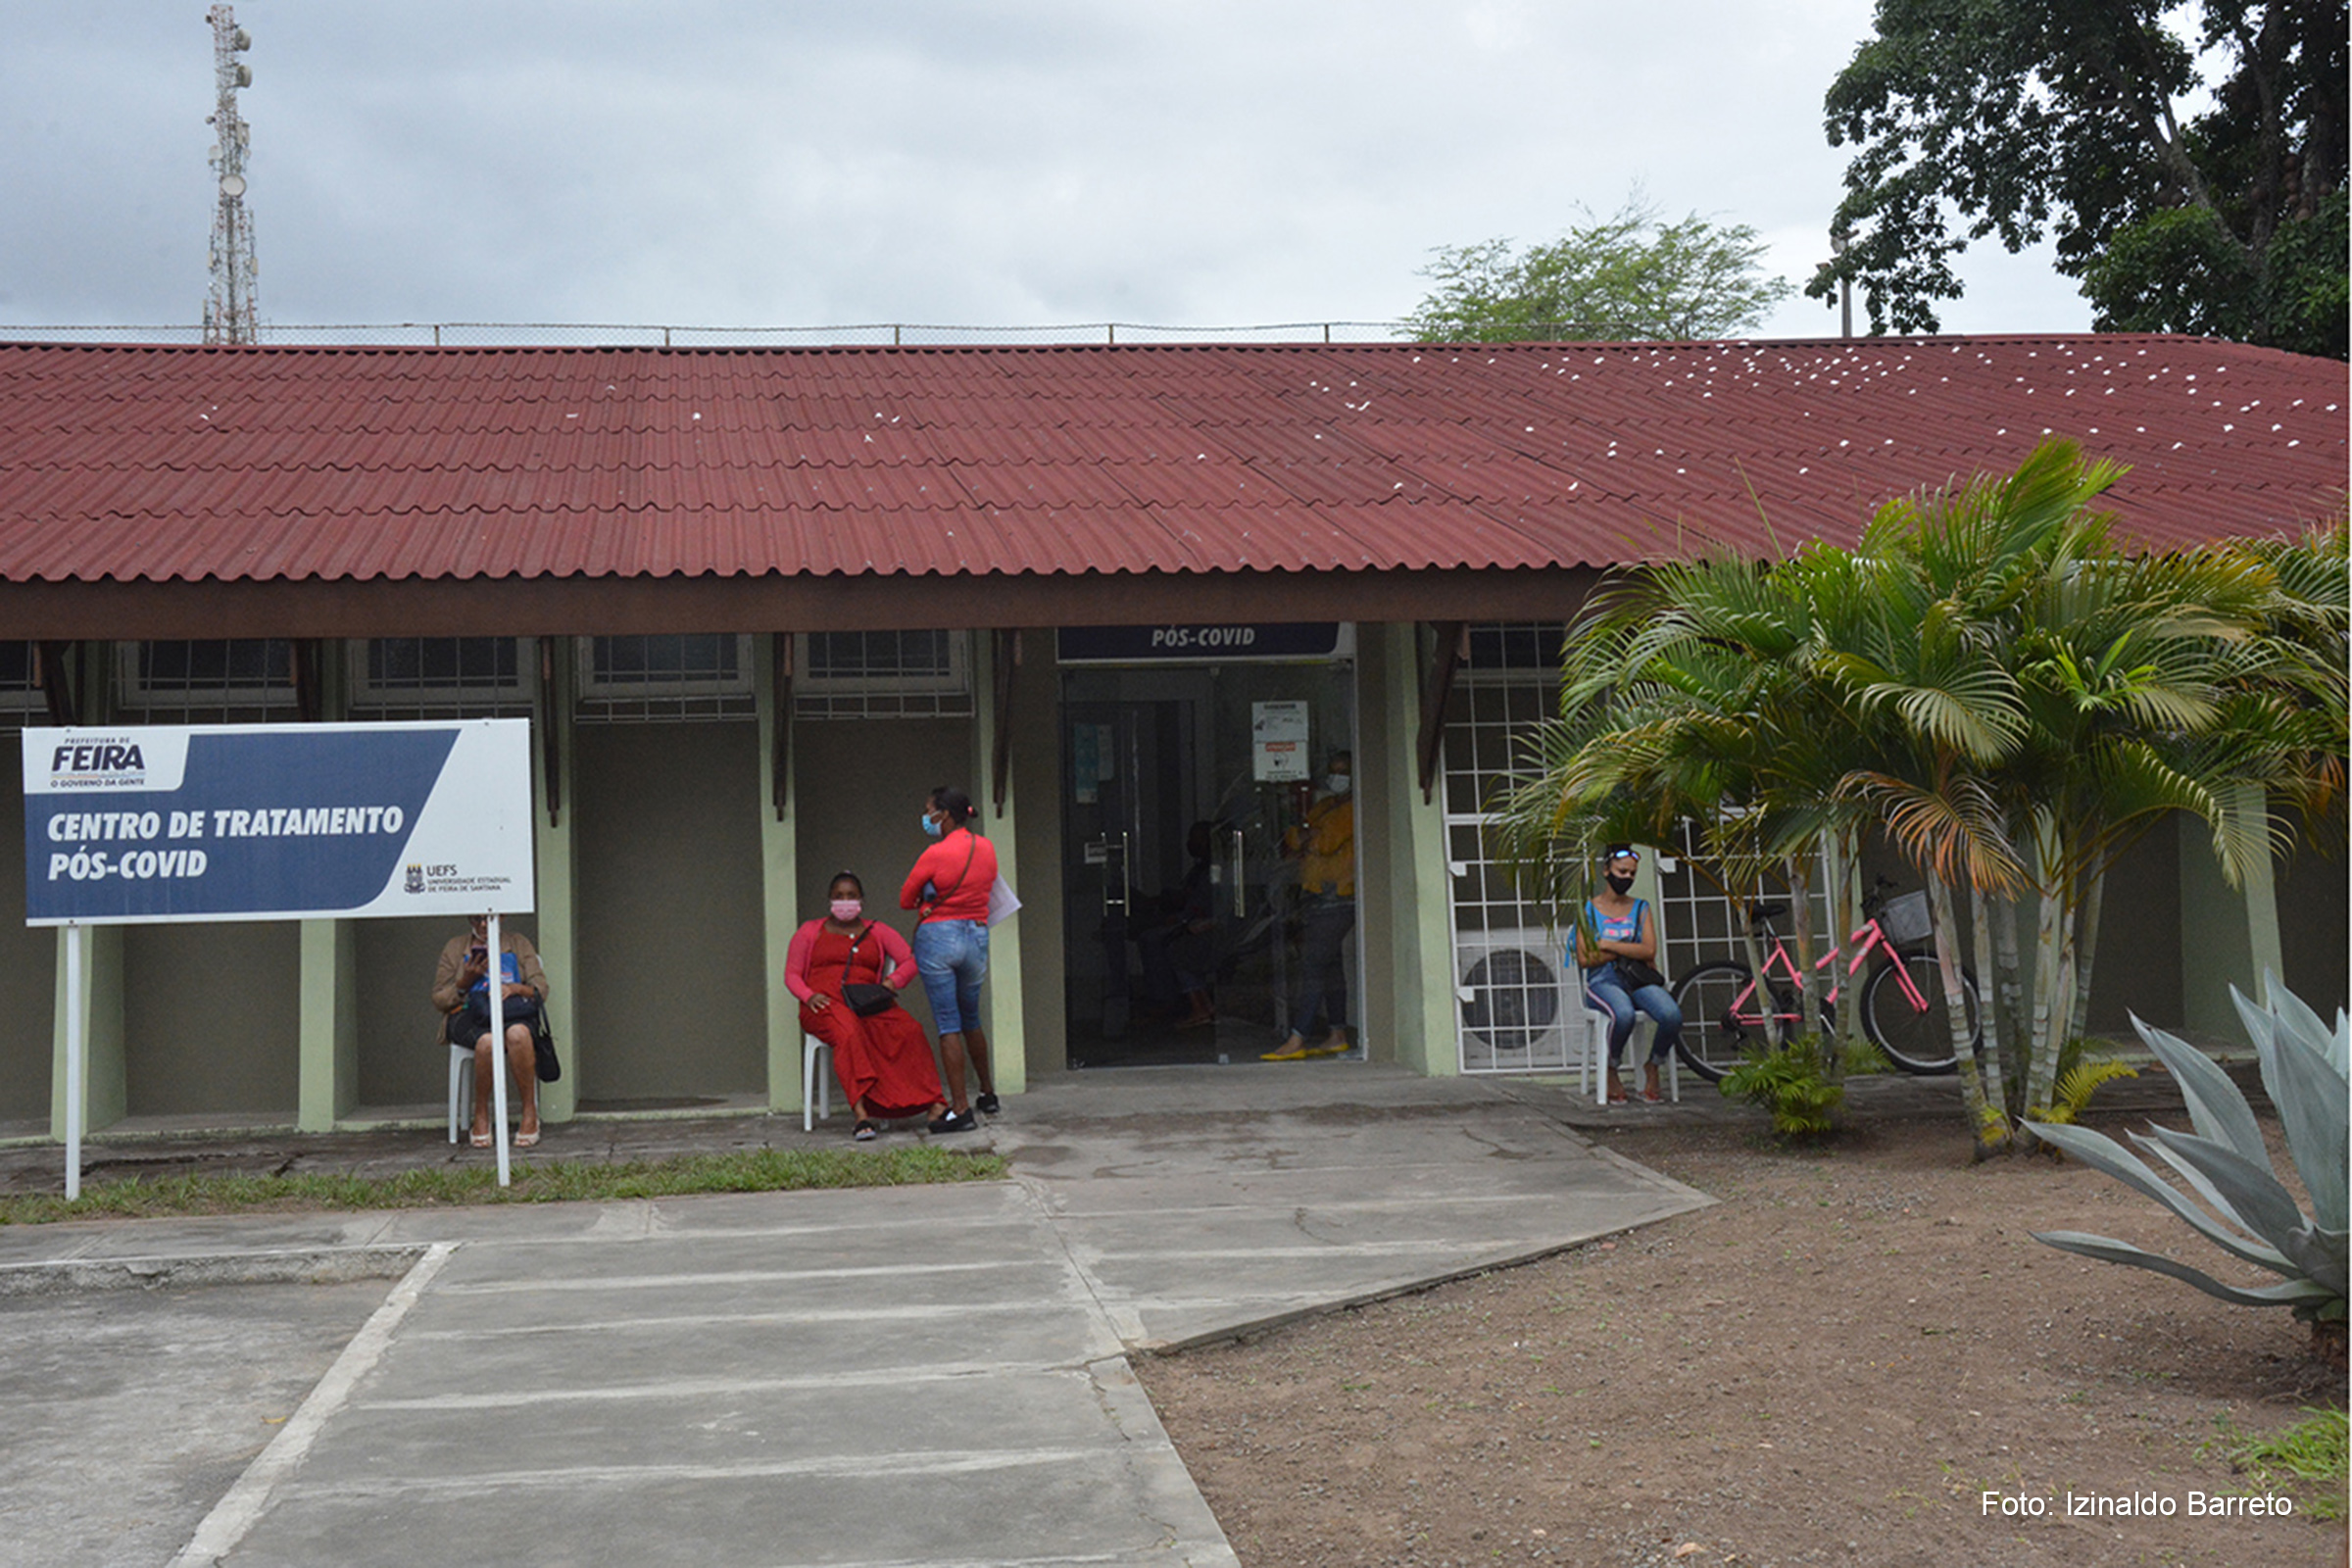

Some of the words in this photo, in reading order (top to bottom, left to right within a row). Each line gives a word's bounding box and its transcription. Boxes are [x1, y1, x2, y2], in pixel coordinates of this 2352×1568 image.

[1152, 624, 1255, 647] PÓS-COVID
[52, 744, 145, 771] FEIRA
[50, 779, 59, 788] O
[47, 811, 161, 842] CENTRO
[168, 810, 206, 839] DE
[214, 806, 404, 838] TRATAMENTO
[47, 845, 208, 881] PÓS-COVID
[426, 864, 458, 877] UEFS
